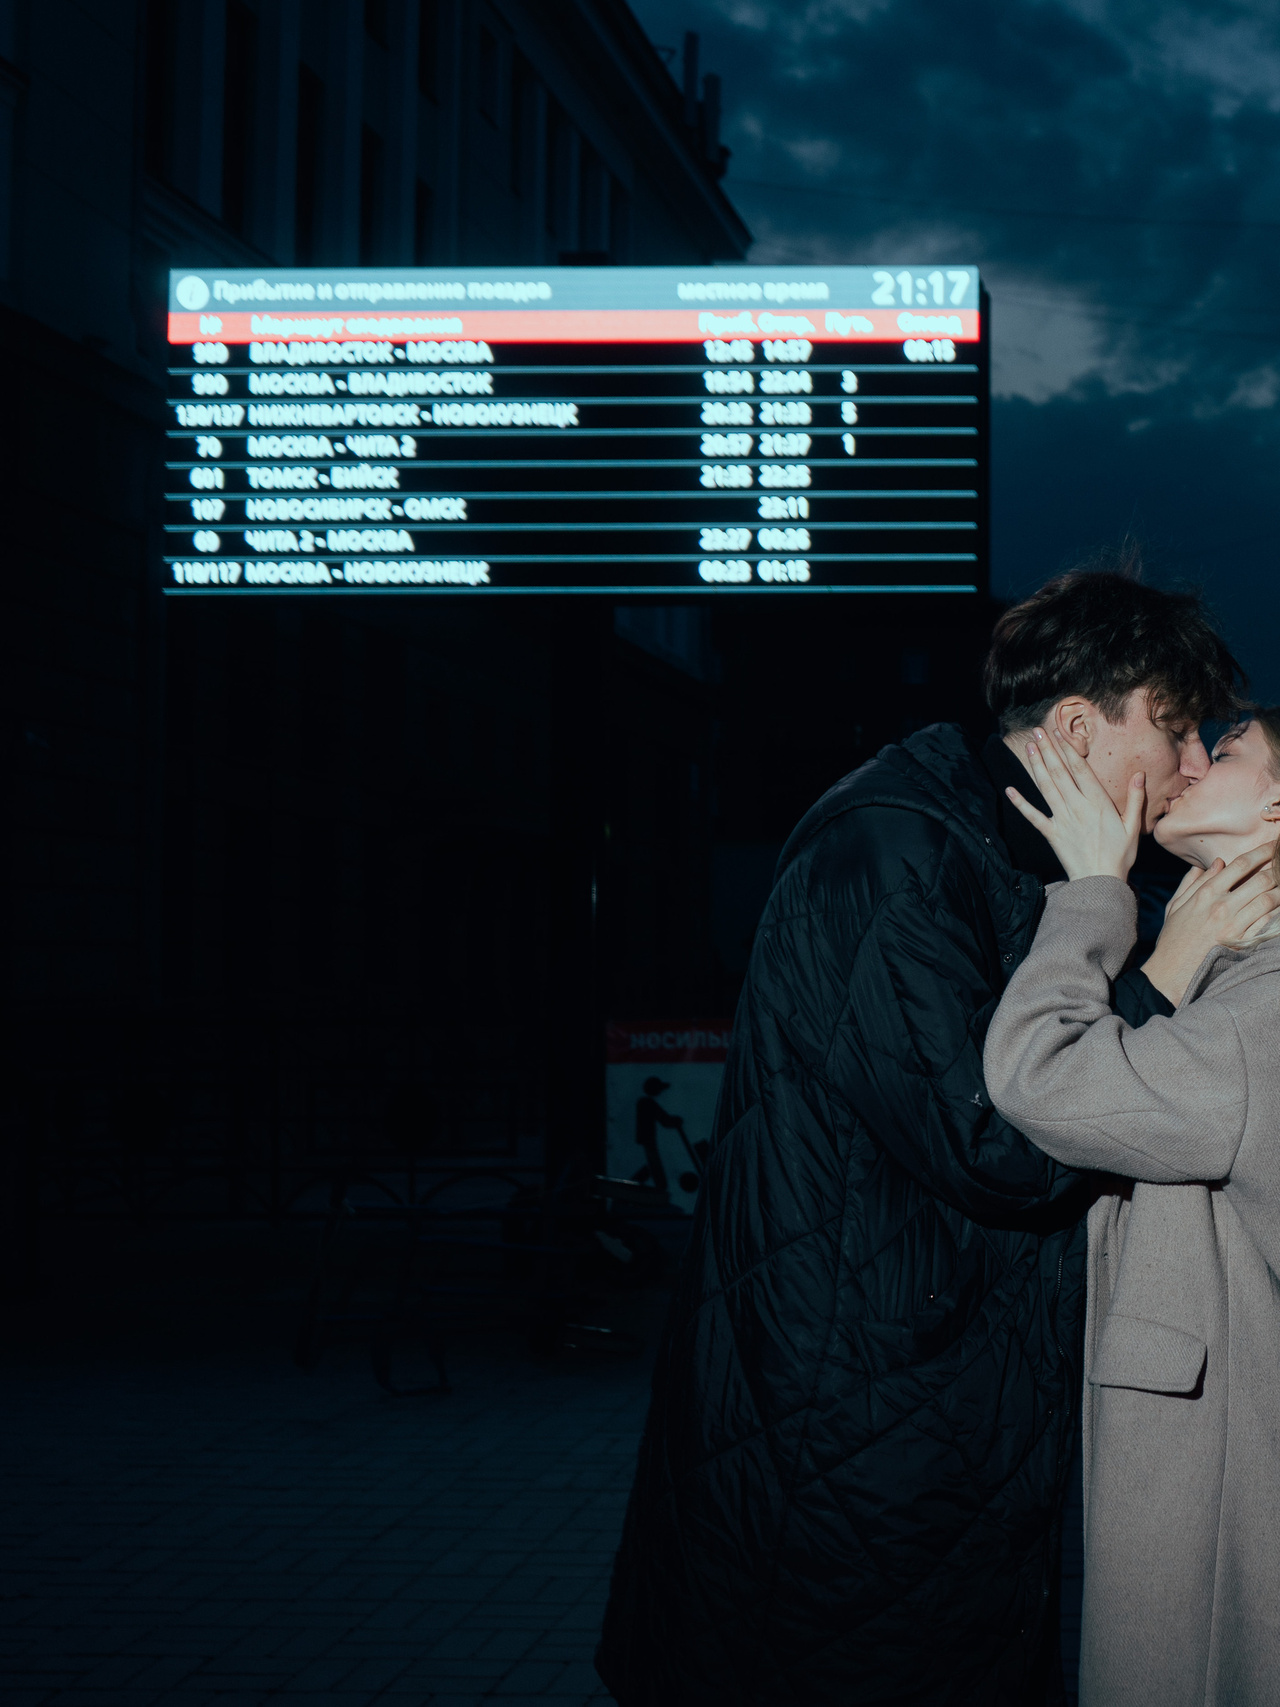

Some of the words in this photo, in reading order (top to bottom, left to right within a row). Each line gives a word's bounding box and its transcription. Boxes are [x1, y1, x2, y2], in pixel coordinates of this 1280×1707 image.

[213, 278, 315, 304] Прибытие
[317, 283, 333, 300] и
[334, 282, 466, 304] отправление
[467, 281, 552, 303] поездов
[871, 271, 970, 306] 21:17
[249, 340, 394, 366] ВЛАДИВОСТОК
[405, 340, 494, 364] МОСКВА
[249, 372, 336, 396] МОСКВА
[348, 371, 494, 397] ВЛАДИВОСТОК
[840, 370, 858, 394] 3
[248, 403, 421, 428] НИЖНЕВАРТОВСК
[432, 402, 580, 428] НОВОКУЗНЕЦК
[841, 401, 858, 425] 5
[196, 435, 223, 458] 70
[247, 435, 335, 458] МОСКВА
[345, 434, 401, 458] ЧИТА
[400, 434, 417, 458] 2
[842, 432, 856, 456] 1
[246, 466, 319, 489] ТОМСК
[330, 463, 400, 489] БИЙСК
[246, 497, 393, 521] НОВОСИБИРСК
[403, 497, 468, 520] ОМСК
[245, 529, 300, 552] ЧИТА
[299, 529, 315, 552] 2
[327, 529, 415, 552] МОСКВА
[245, 561, 333, 584] МОСКВА
[344, 560, 491, 585] НОВОКУЗНЕЦК
